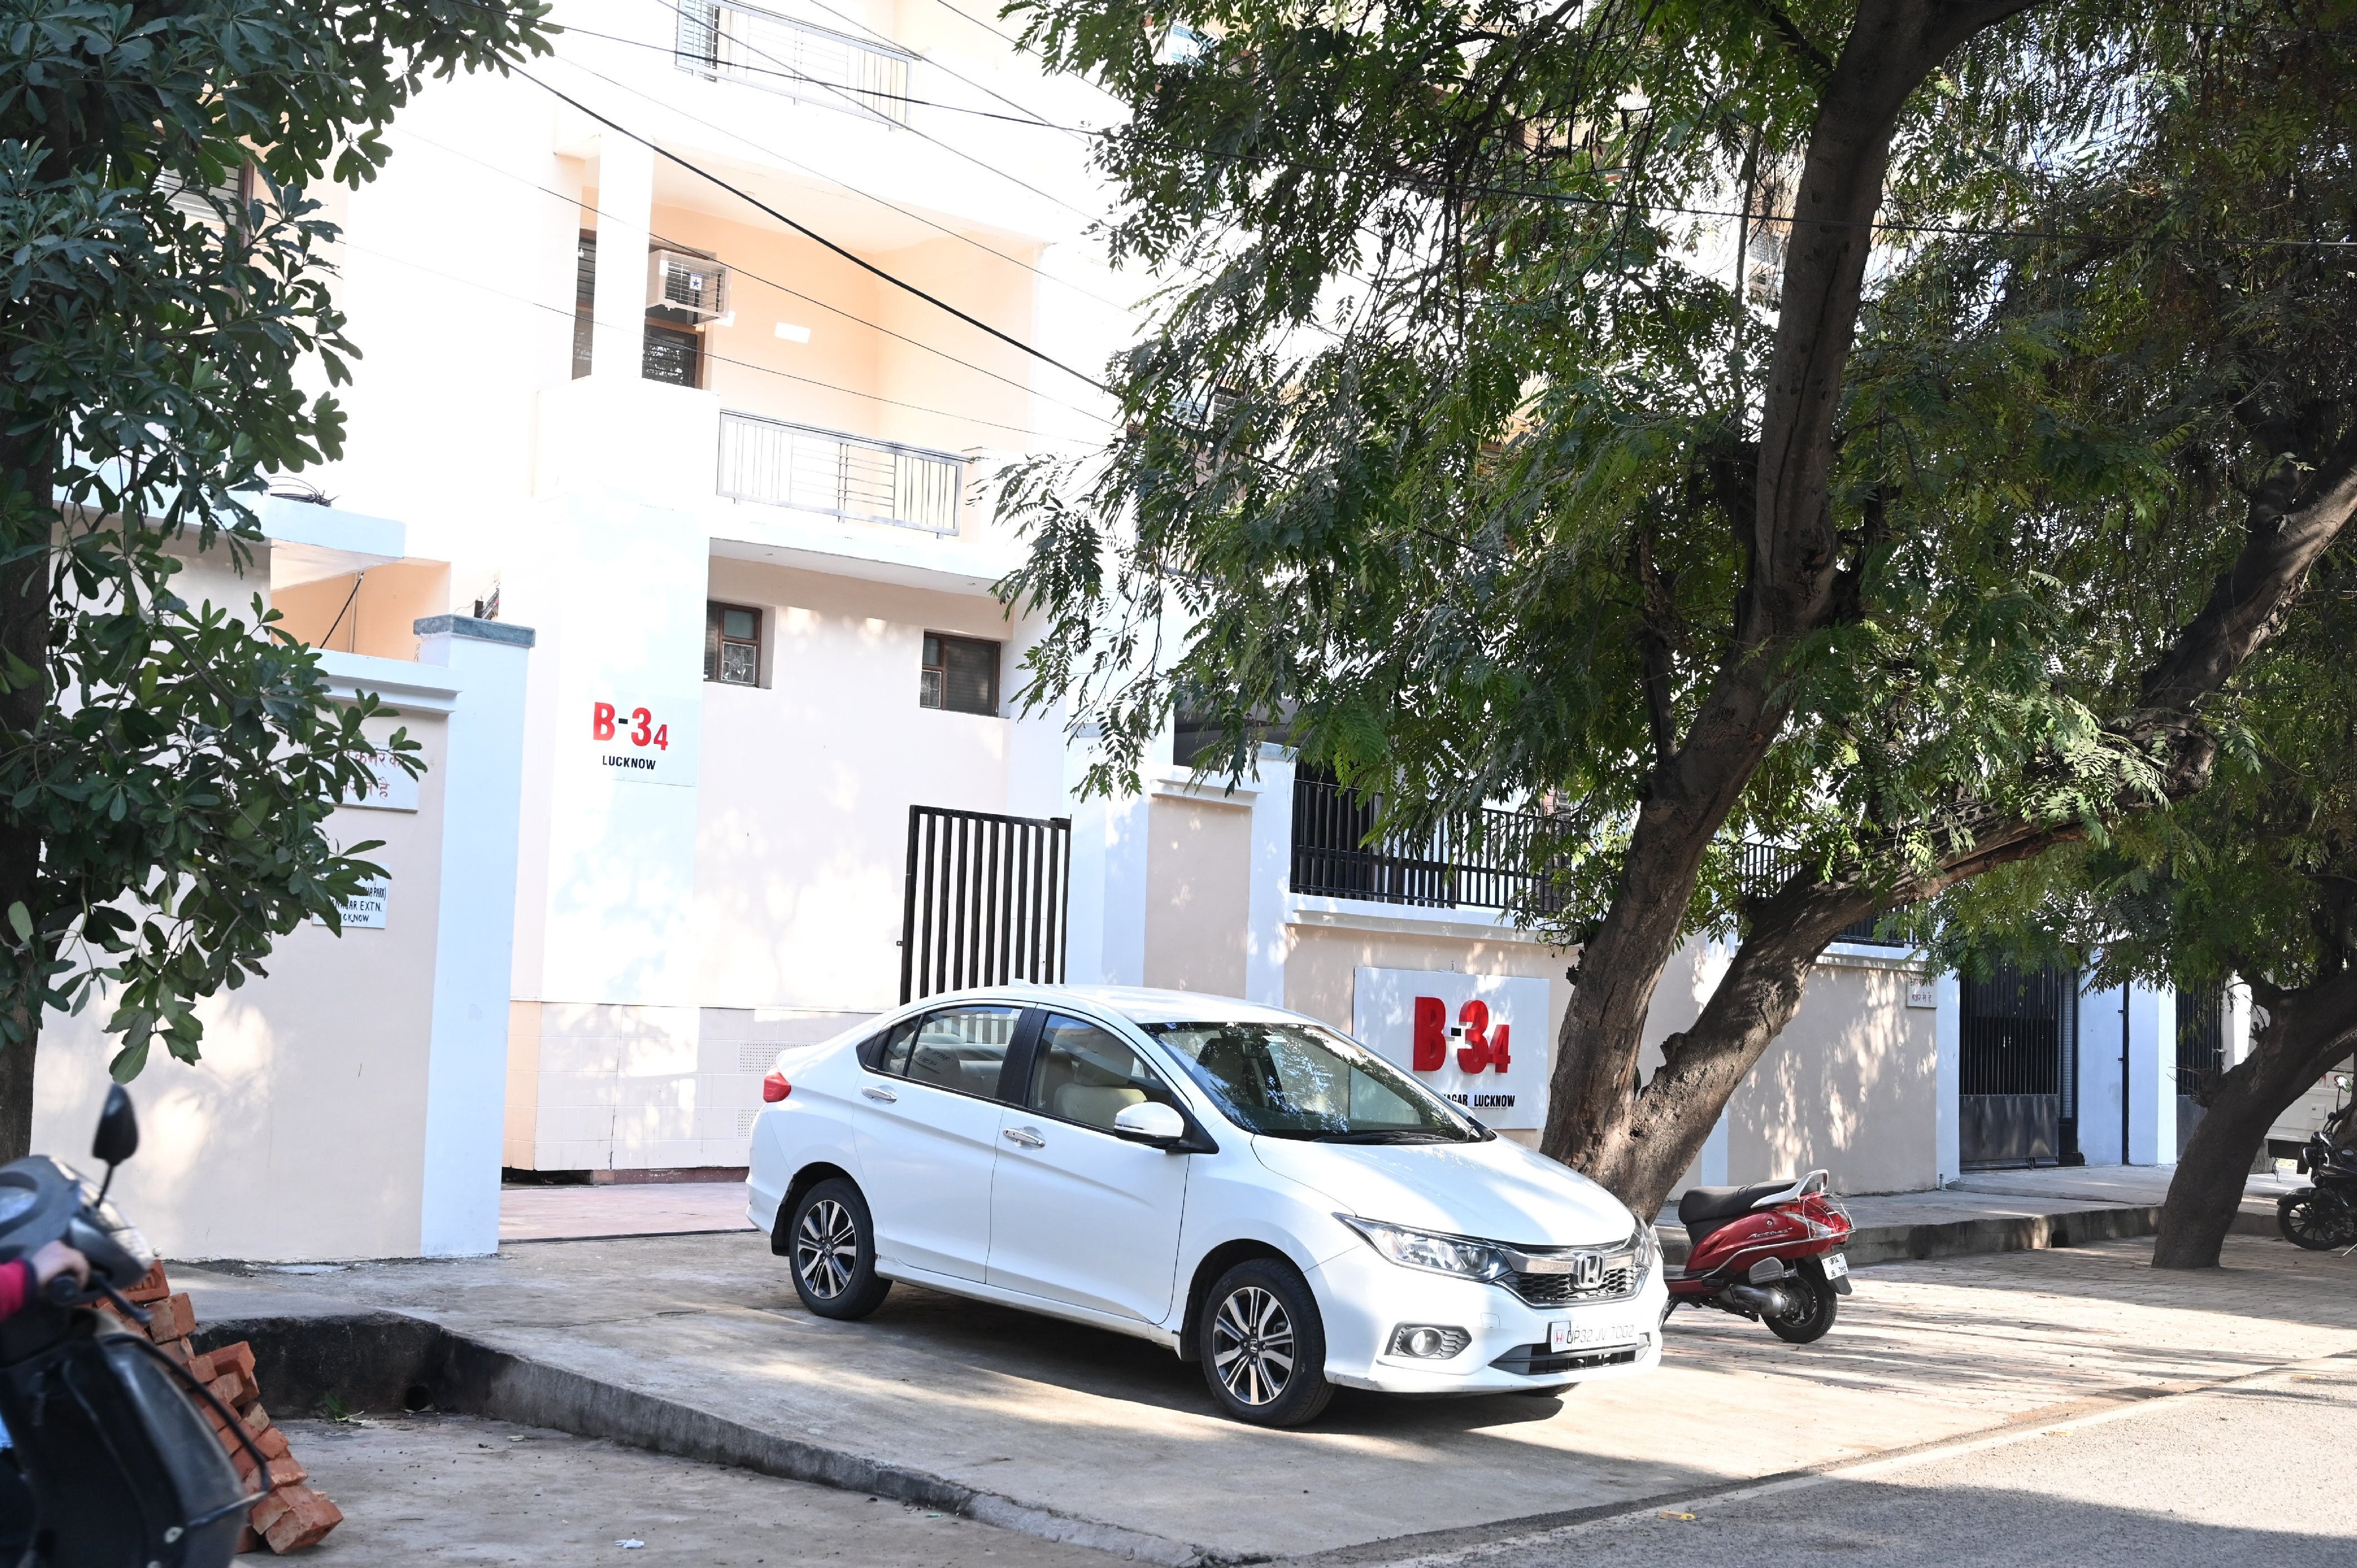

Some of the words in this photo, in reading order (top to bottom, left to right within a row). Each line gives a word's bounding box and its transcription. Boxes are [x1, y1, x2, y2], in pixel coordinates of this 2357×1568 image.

[593, 702, 668, 751] B-34
[602, 755, 656, 770] LUCKNOW
[360, 900, 382, 912] EXTN.
[1413, 996, 1511, 1074] B-34
[1474, 1094, 1515, 1107] LUCKNOW
[1566, 1329, 1593, 1344] UP32
[1596, 1327, 1608, 1341] JV
[1611, 1325, 1634, 1339] 7002
